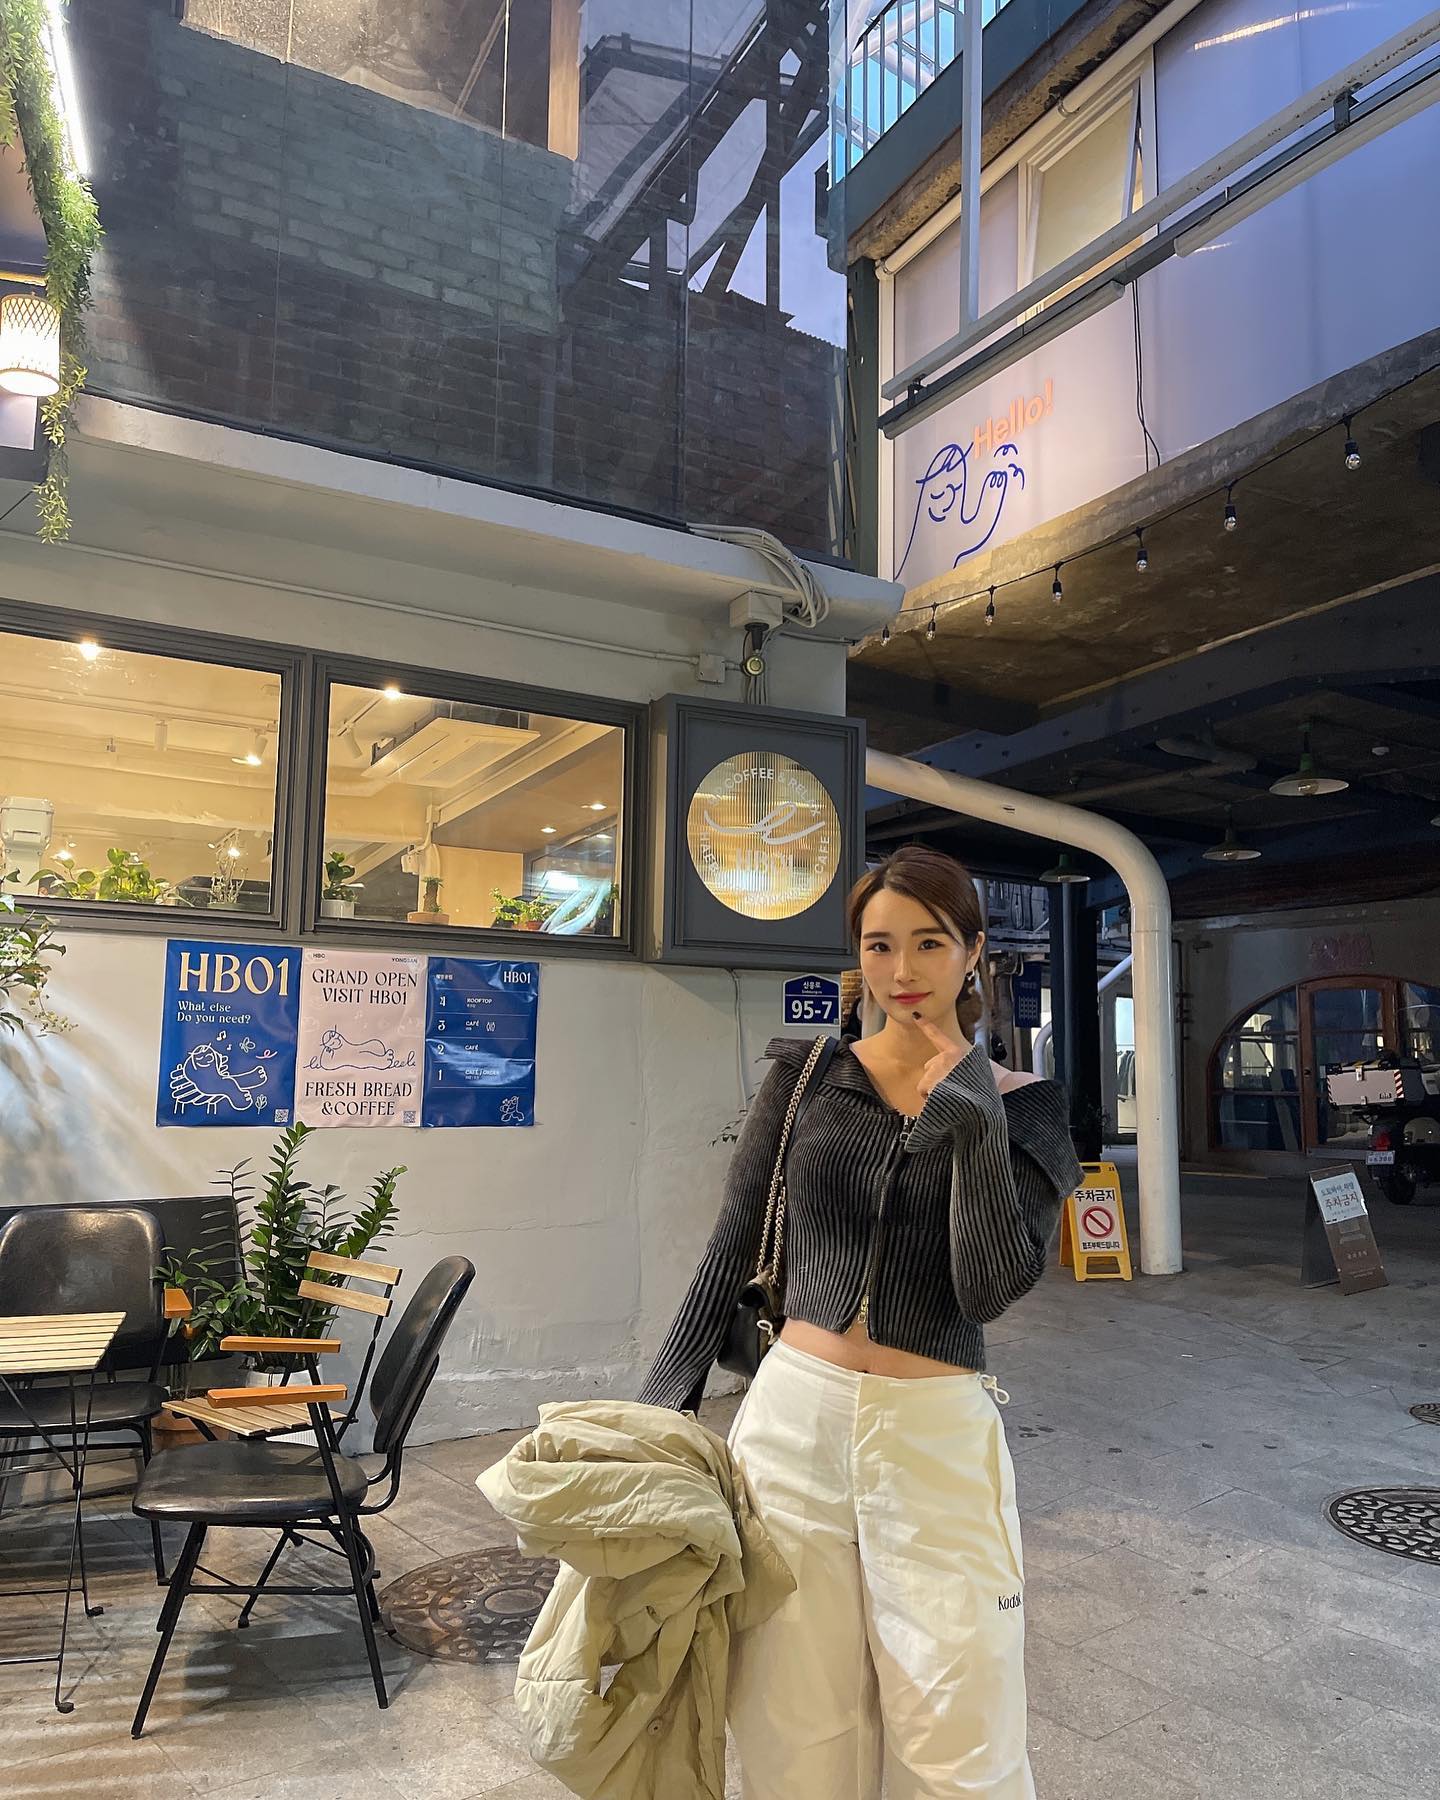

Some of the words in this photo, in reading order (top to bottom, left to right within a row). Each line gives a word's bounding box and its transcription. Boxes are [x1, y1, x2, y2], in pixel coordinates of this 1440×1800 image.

[974, 377, 1053, 460] Hello!
[725, 768, 774, 788] COFFEE
[815, 836, 830, 874] CAFE
[312, 968, 368, 985] GRAND
[375, 971, 418, 987] OPEN
[322, 987, 364, 1003] VISIT
[178, 1000, 206, 1012] What
[209, 1002, 232, 1013] else
[791, 1000, 832, 1019] 95-7
[177, 1012, 192, 1022] Do
[195, 1014, 215, 1024] you
[218, 1014, 251, 1024] need?
[437, 1020, 446, 1031] 3
[437, 1044, 445, 1055] 2
[438, 1069, 443, 1081] 1
[305, 1081, 356, 1097] FRESH
[363, 1082, 412, 1097] BREAD
[321, 1101, 396, 1116] &COFFEE
[1075, 1189, 1116, 1202] 주차금지
[1325, 1191, 1359, 1210] 주차금지
